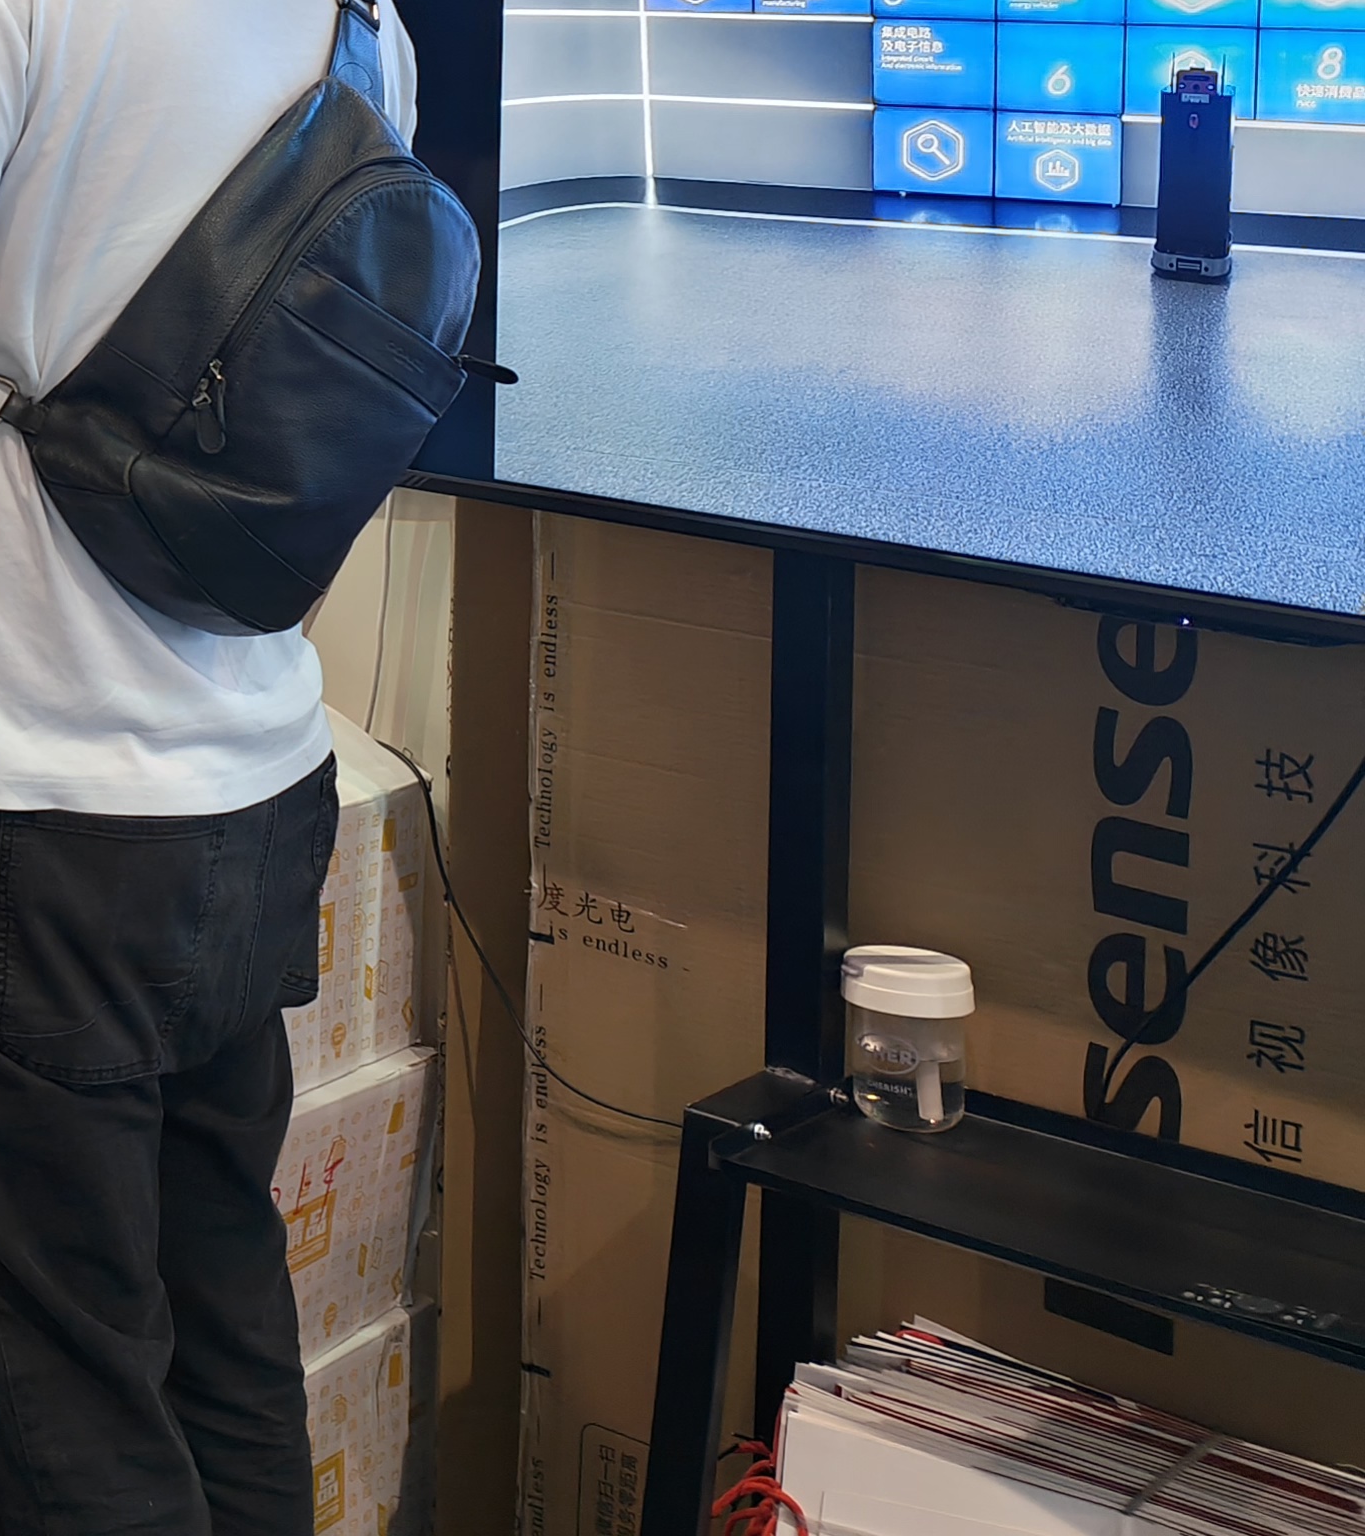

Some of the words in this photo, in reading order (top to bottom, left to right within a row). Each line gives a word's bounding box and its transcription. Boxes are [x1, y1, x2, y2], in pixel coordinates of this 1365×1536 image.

[881, 39, 944, 54] 及电子信息
[1316, 46, 1344, 80] 8
[1046, 65, 1072, 96] 6
[540, 593, 559, 680] endless
[537, 690, 556, 713] is
[534, 726, 559, 849] Technology
[548, 919, 570, 943] is
[582, 930, 670, 971] endless
[1242, 746, 1315, 1165] 信视像科技
[530, 1024, 550, 1111] endless
[531, 1122, 549, 1146] is
[528, 1159, 552, 1283] Technology
